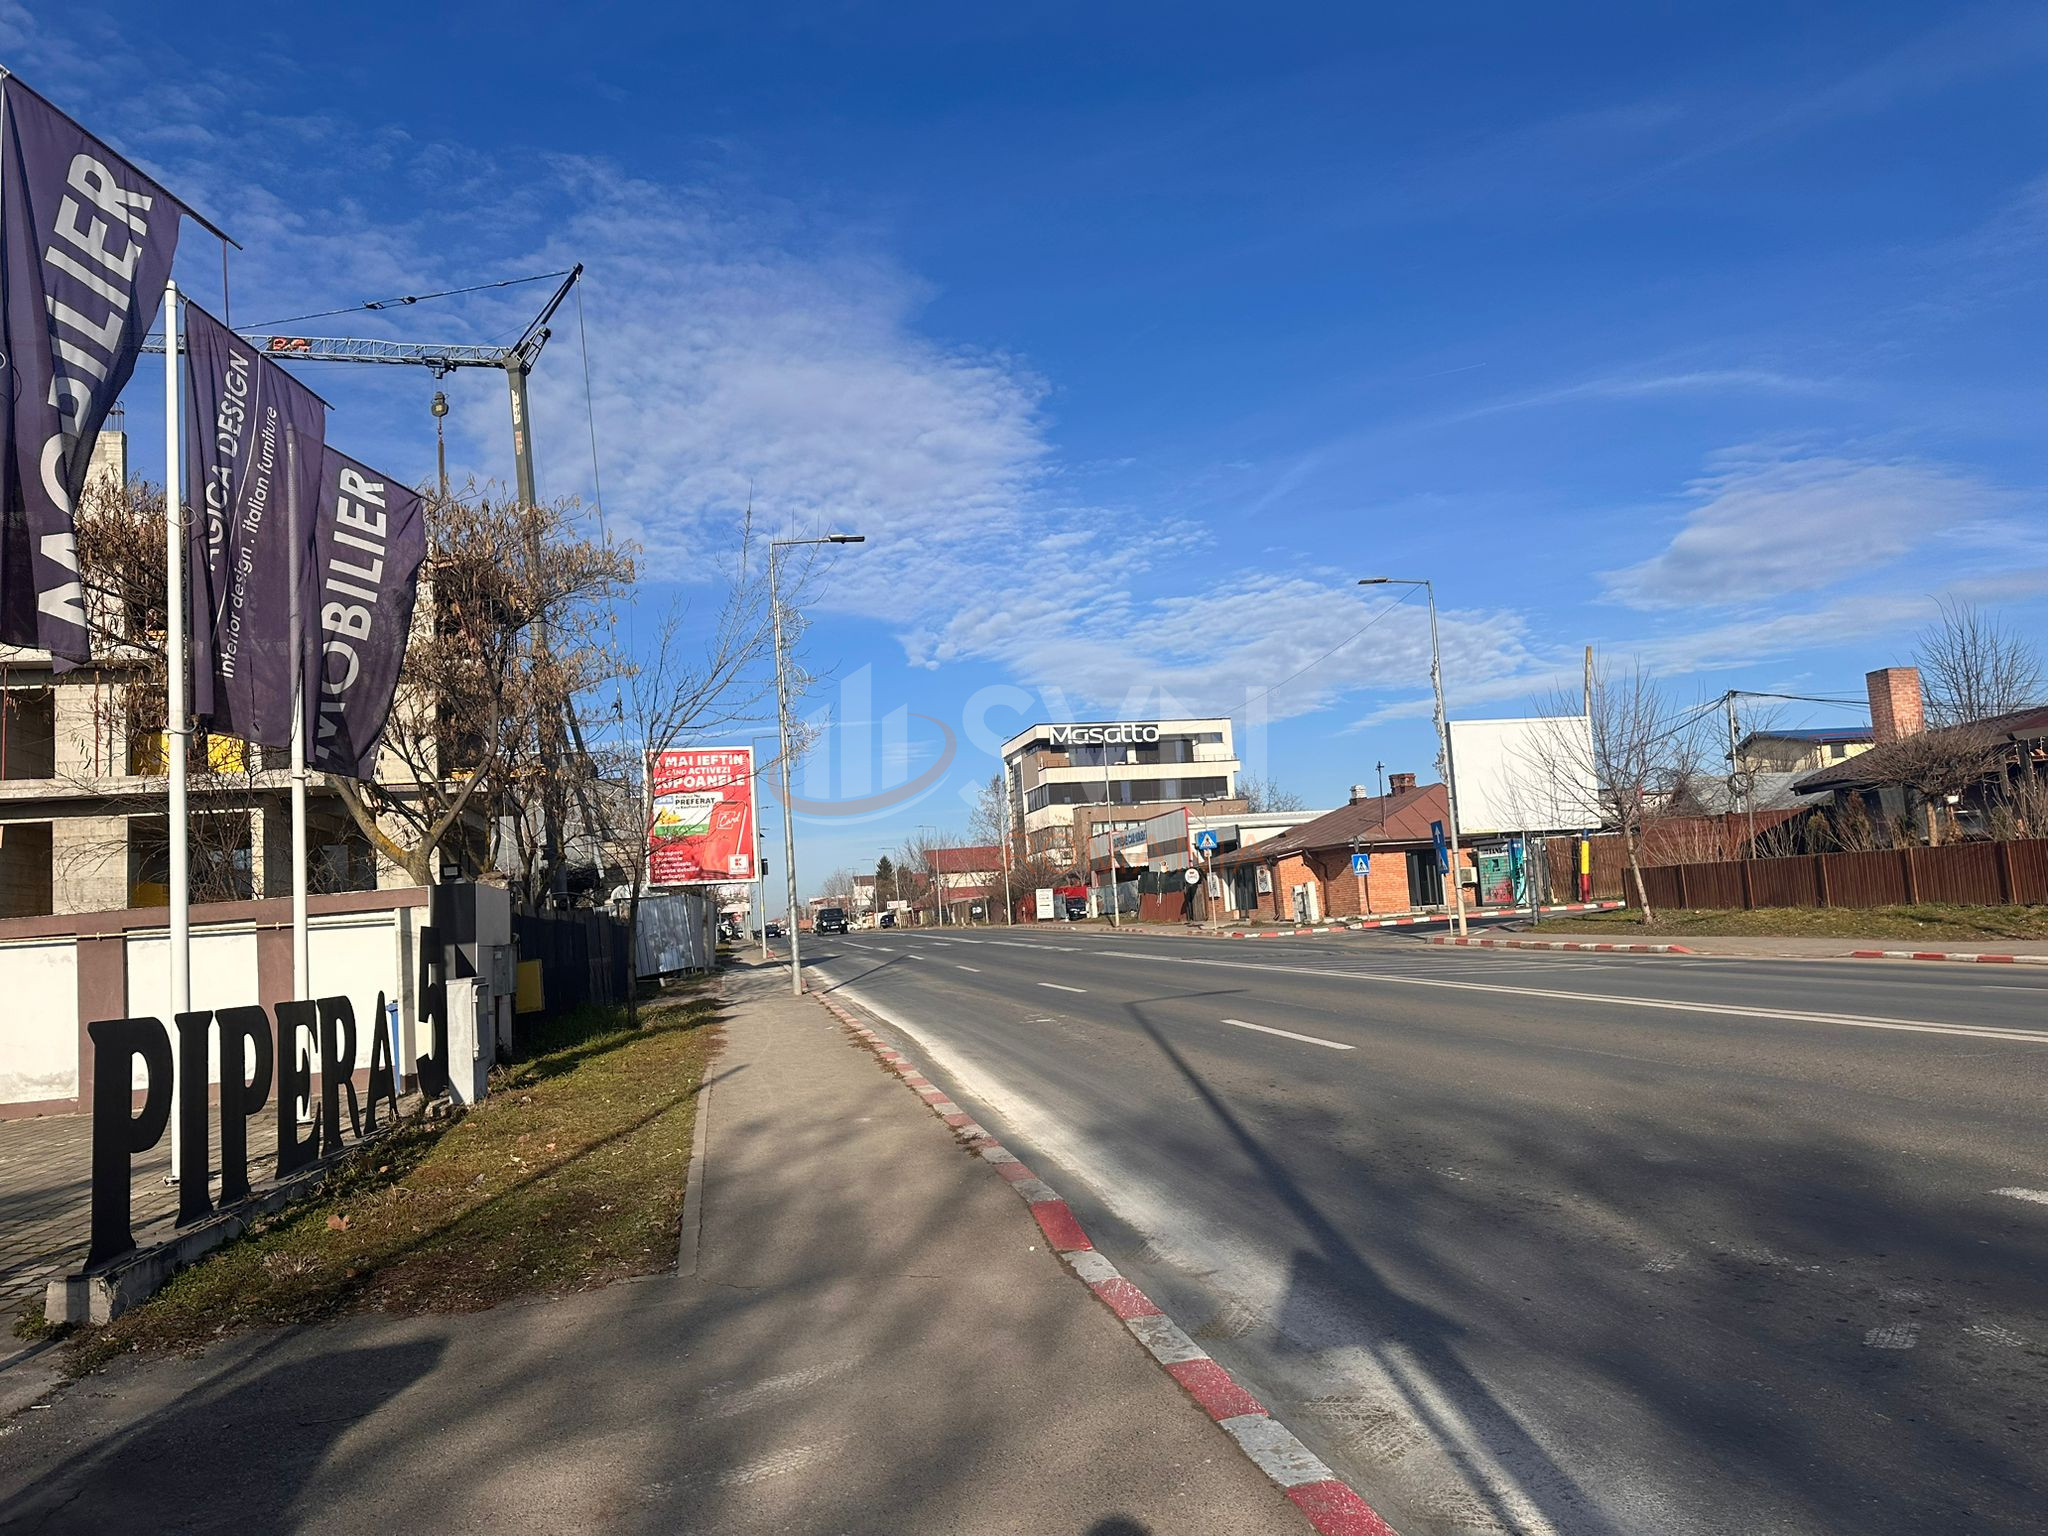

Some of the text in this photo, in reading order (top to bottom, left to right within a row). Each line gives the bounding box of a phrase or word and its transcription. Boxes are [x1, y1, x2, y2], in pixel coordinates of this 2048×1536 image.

[217, 349, 249, 458] DESIGN
[215, 406, 278, 679] interior design italian furniture
[1050, 724, 1160, 745] Masatto
[664, 755, 693, 767] MAI
[697, 754, 743, 766] IEFTIN
[688, 766, 731, 775] ACTIVEZI
[675, 797, 716, 806] PREFERAT
[719, 811, 741, 827] Card
[83, 990, 399, 1273] PIPERA
